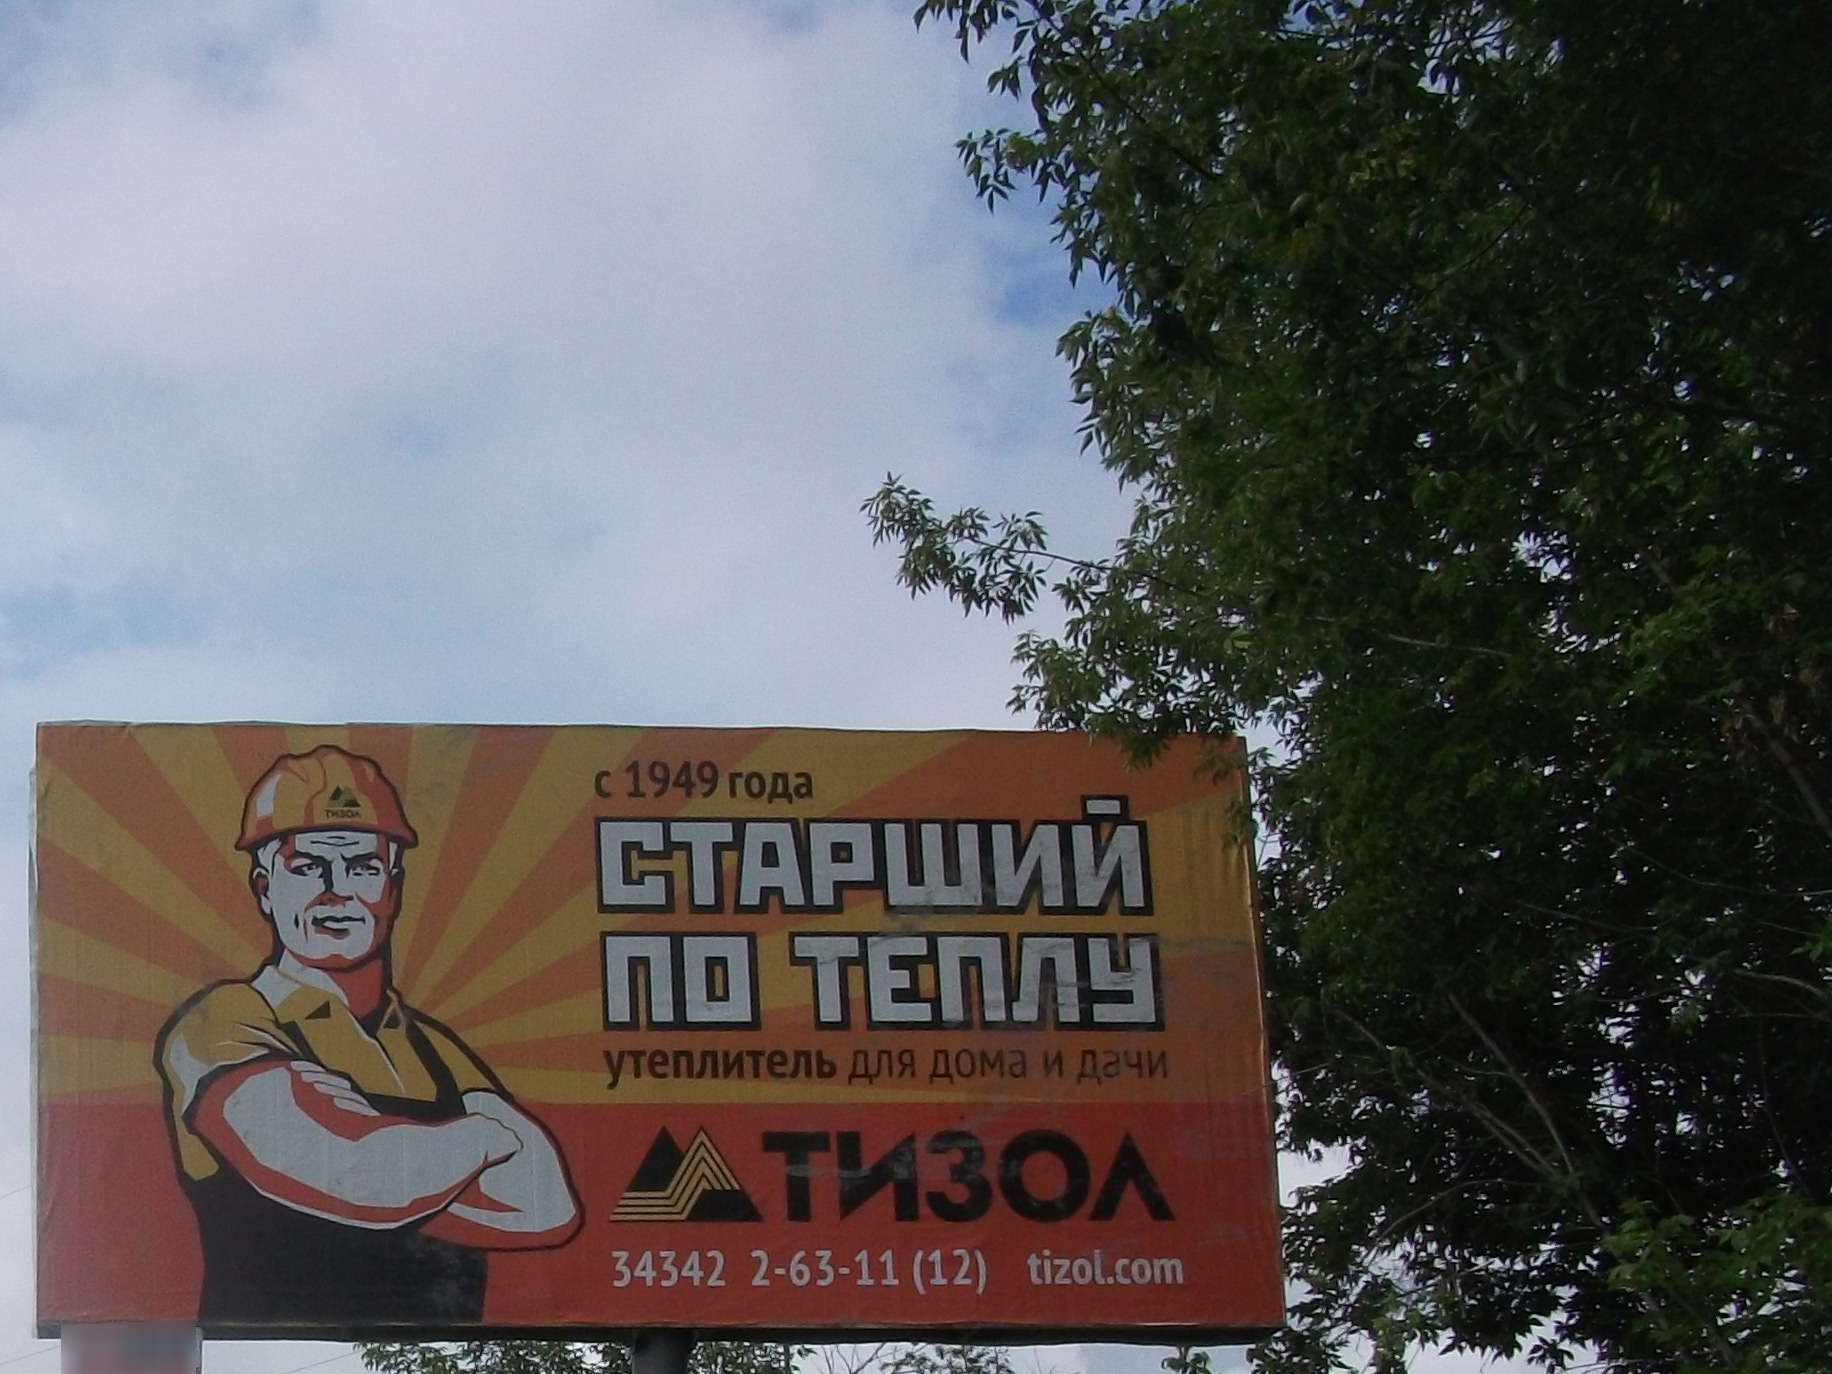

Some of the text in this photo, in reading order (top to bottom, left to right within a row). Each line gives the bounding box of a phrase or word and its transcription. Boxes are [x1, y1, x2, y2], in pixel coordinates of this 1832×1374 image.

[594, 760, 813, 803] с 1949 года
[594, 794, 1154, 916] СТАРШИЙ
[600, 931, 1164, 1031] ПО ТЕПЛУ
[603, 1049, 1168, 1089] утеплитель для дома и дачи
[762, 1128, 1176, 1223] ТИЗОЛ
[612, 1249, 1183, 1294] 34342 2-63-11 (12) tizol.com
